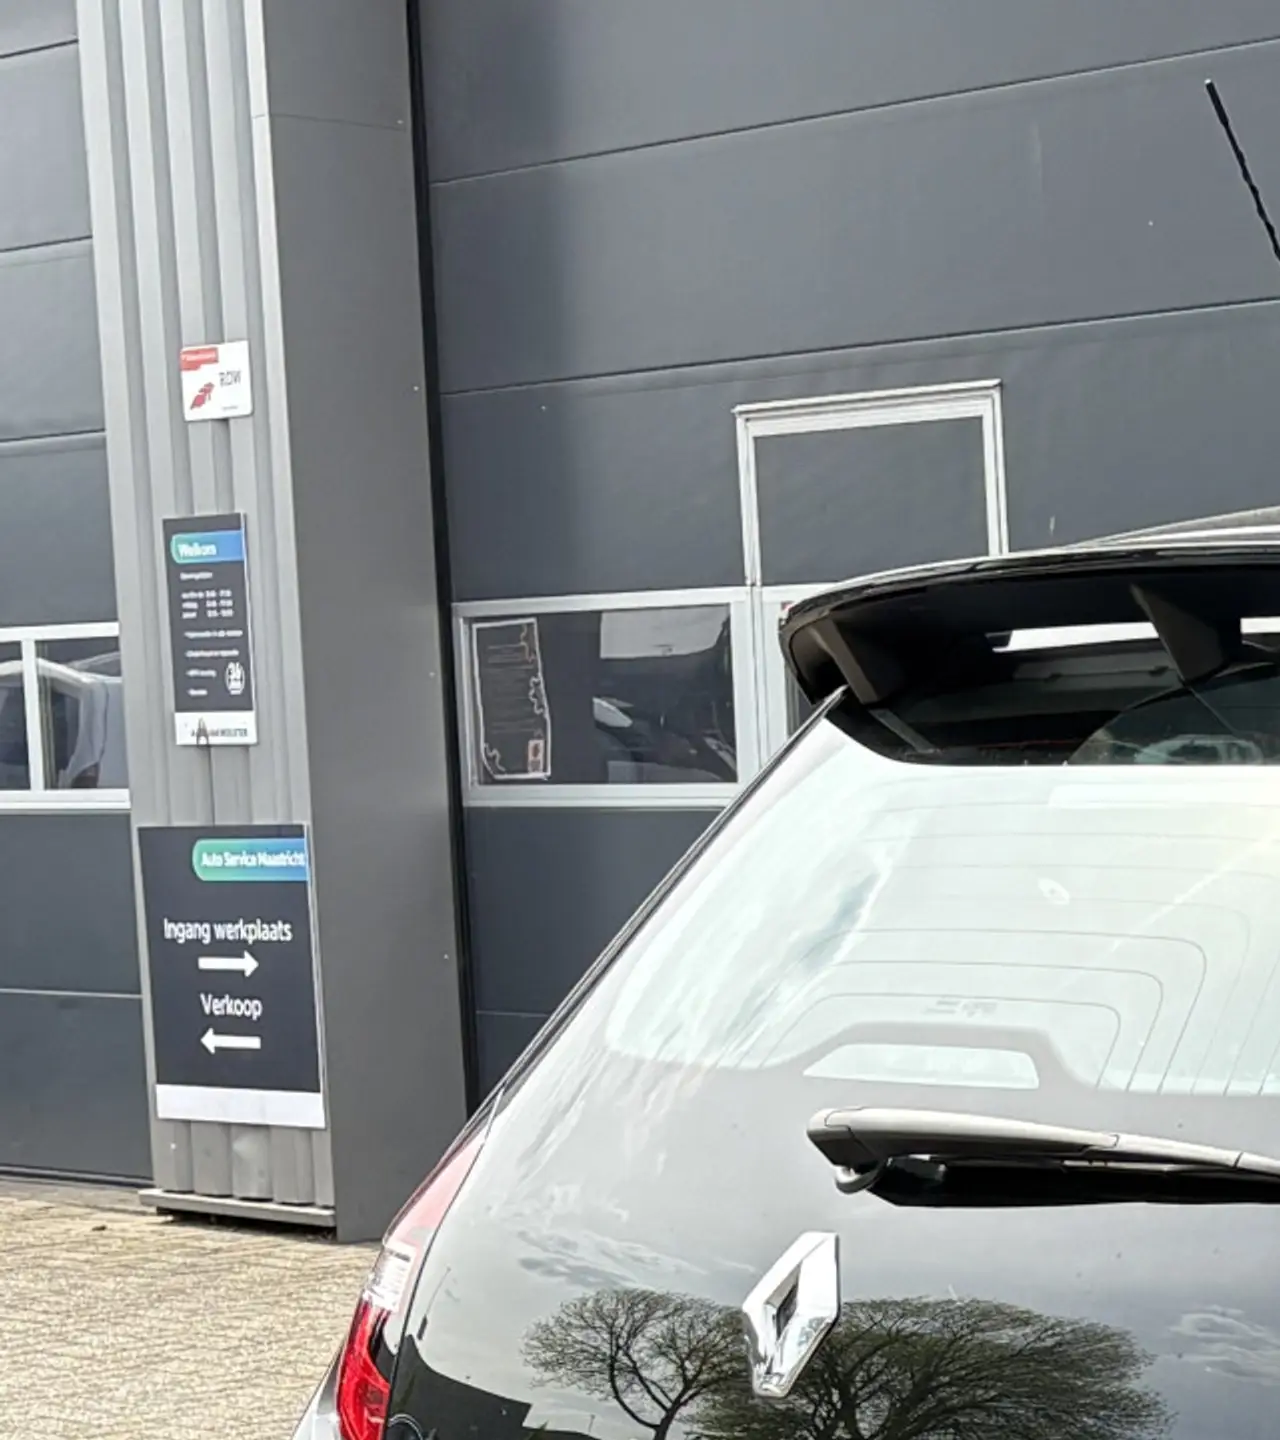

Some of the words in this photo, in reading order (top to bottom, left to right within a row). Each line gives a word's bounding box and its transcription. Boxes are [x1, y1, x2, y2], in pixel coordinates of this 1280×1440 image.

[201, 852, 223, 867] Auto
[224, 851, 256, 867] Service
[257, 850, 306, 867] Maastricht
[164, 918, 211, 945] Ingang
[213, 918, 293, 945] werkplaats
[200, 993, 263, 1020] Verkoop
